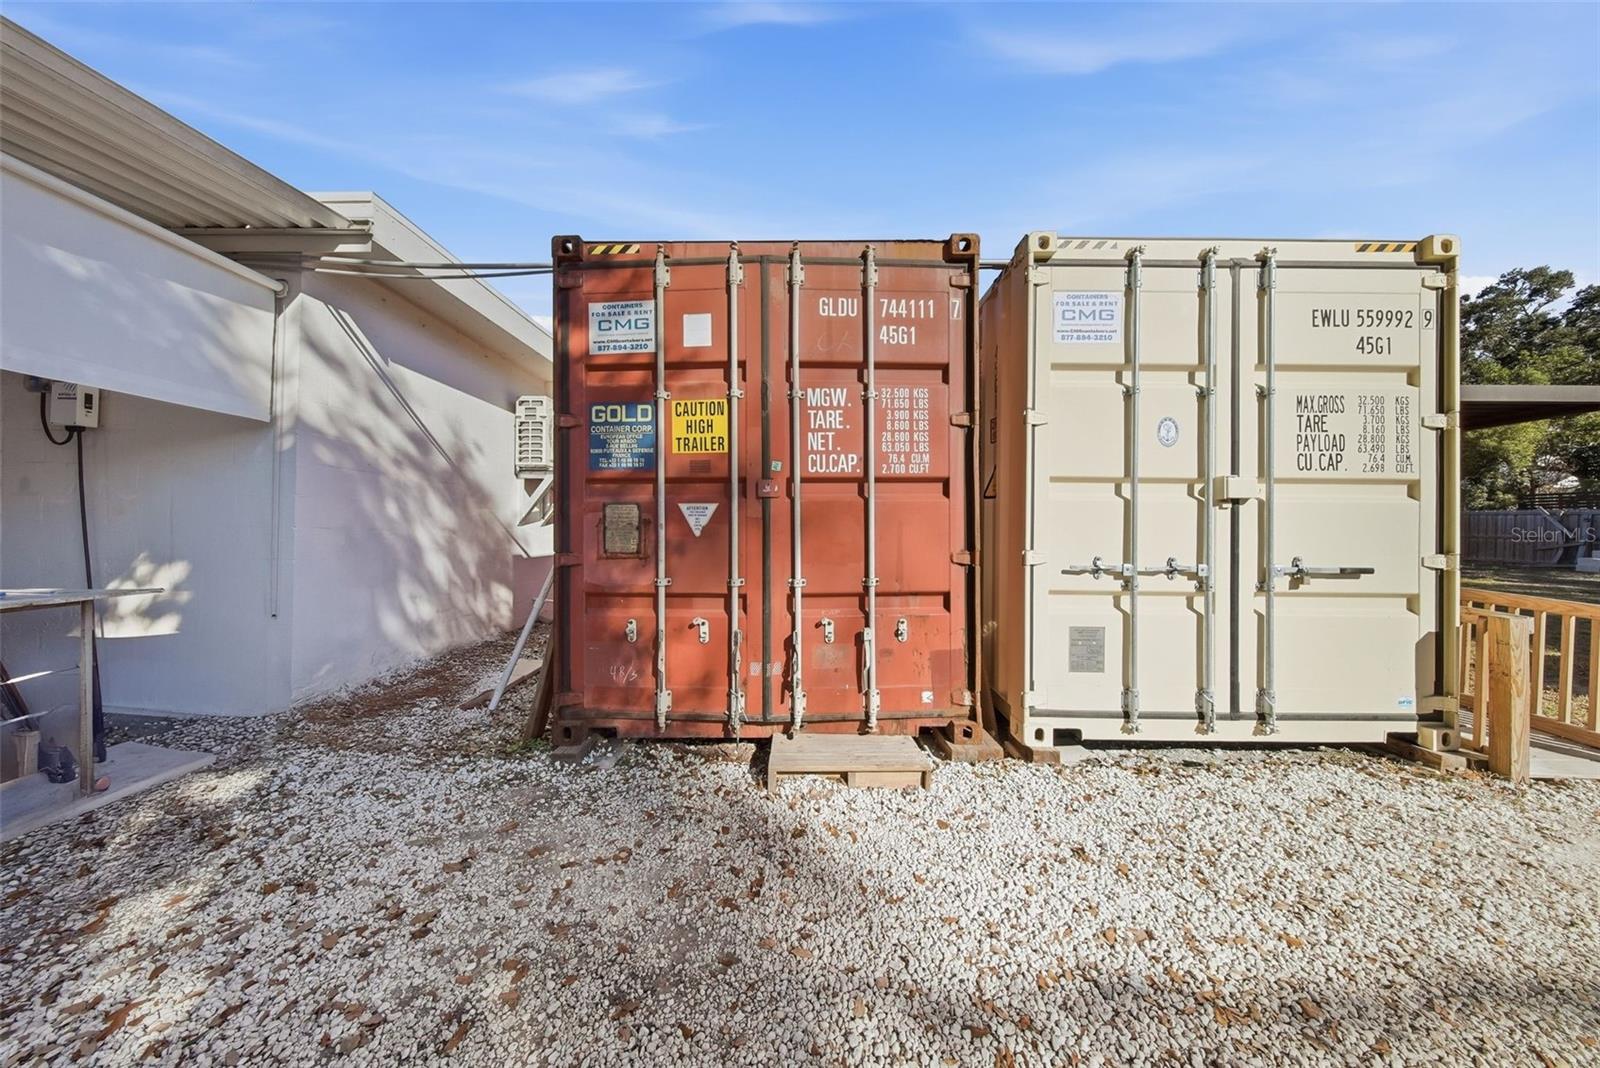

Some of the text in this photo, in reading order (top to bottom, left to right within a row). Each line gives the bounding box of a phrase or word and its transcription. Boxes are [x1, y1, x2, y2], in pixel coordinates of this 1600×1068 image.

[602, 302, 643, 310] CONTAINERS
[819, 297, 960, 319] GLDU 744111 7
[1061, 309, 1115, 321] CMG
[1312, 309, 1432, 328] EWLU 559992 9
[598, 318, 649, 331] CMG
[879, 325, 916, 345] 45G1
[597, 343, 649, 352] 877-894-3210
[1356, 336, 1391, 355] 45G1
[807, 387, 852, 407] MGW.
[881, 388, 929, 398] 32.500 KGS
[881, 399, 929, 408] 71.650 LBS
[1296, 395, 1345, 413] MAX.GROSS
[1357, 396, 1410, 405] 32.500 KGS
[591, 405, 652, 422] GOLD
[675, 401, 725, 417] CAUTION
[1358, 405, 1410, 415] 71.650 LBS
[807, 410, 850, 429] TARE.
[886, 410, 929, 420] 3.900 KGS
[1363, 415, 1410, 425] 3.700 KGS
[590, 424, 653, 433] CONTAINER CORP.
[686, 419, 713, 434] HIGH
[886, 421, 929, 430] 8.600 LBS
[1296, 414, 1328, 433] TARE
[1362, 425, 1410, 434] 8.160 LBS
[807, 432, 841, 451] NET.
[913, 432, 929, 442] KGS
[1357, 434, 1410, 444] 28.800 KGS
[676, 436, 725, 452] TRAILER
[881, 442, 929, 452] 63.050 LBS
[1296, 434, 1345, 452] PAYLOAD
[1358, 444, 1410, 453] 63.490 LBS
[888, 453, 905, 463] 76.4
[1296, 453, 1348, 471] CU.CAP.
[1368, 454, 1385, 463] 76.4
[808, 454, 860, 473] CU.CAP.
[882, 463, 905, 473] 2.700
[1362, 463, 1385, 472] 2.698
